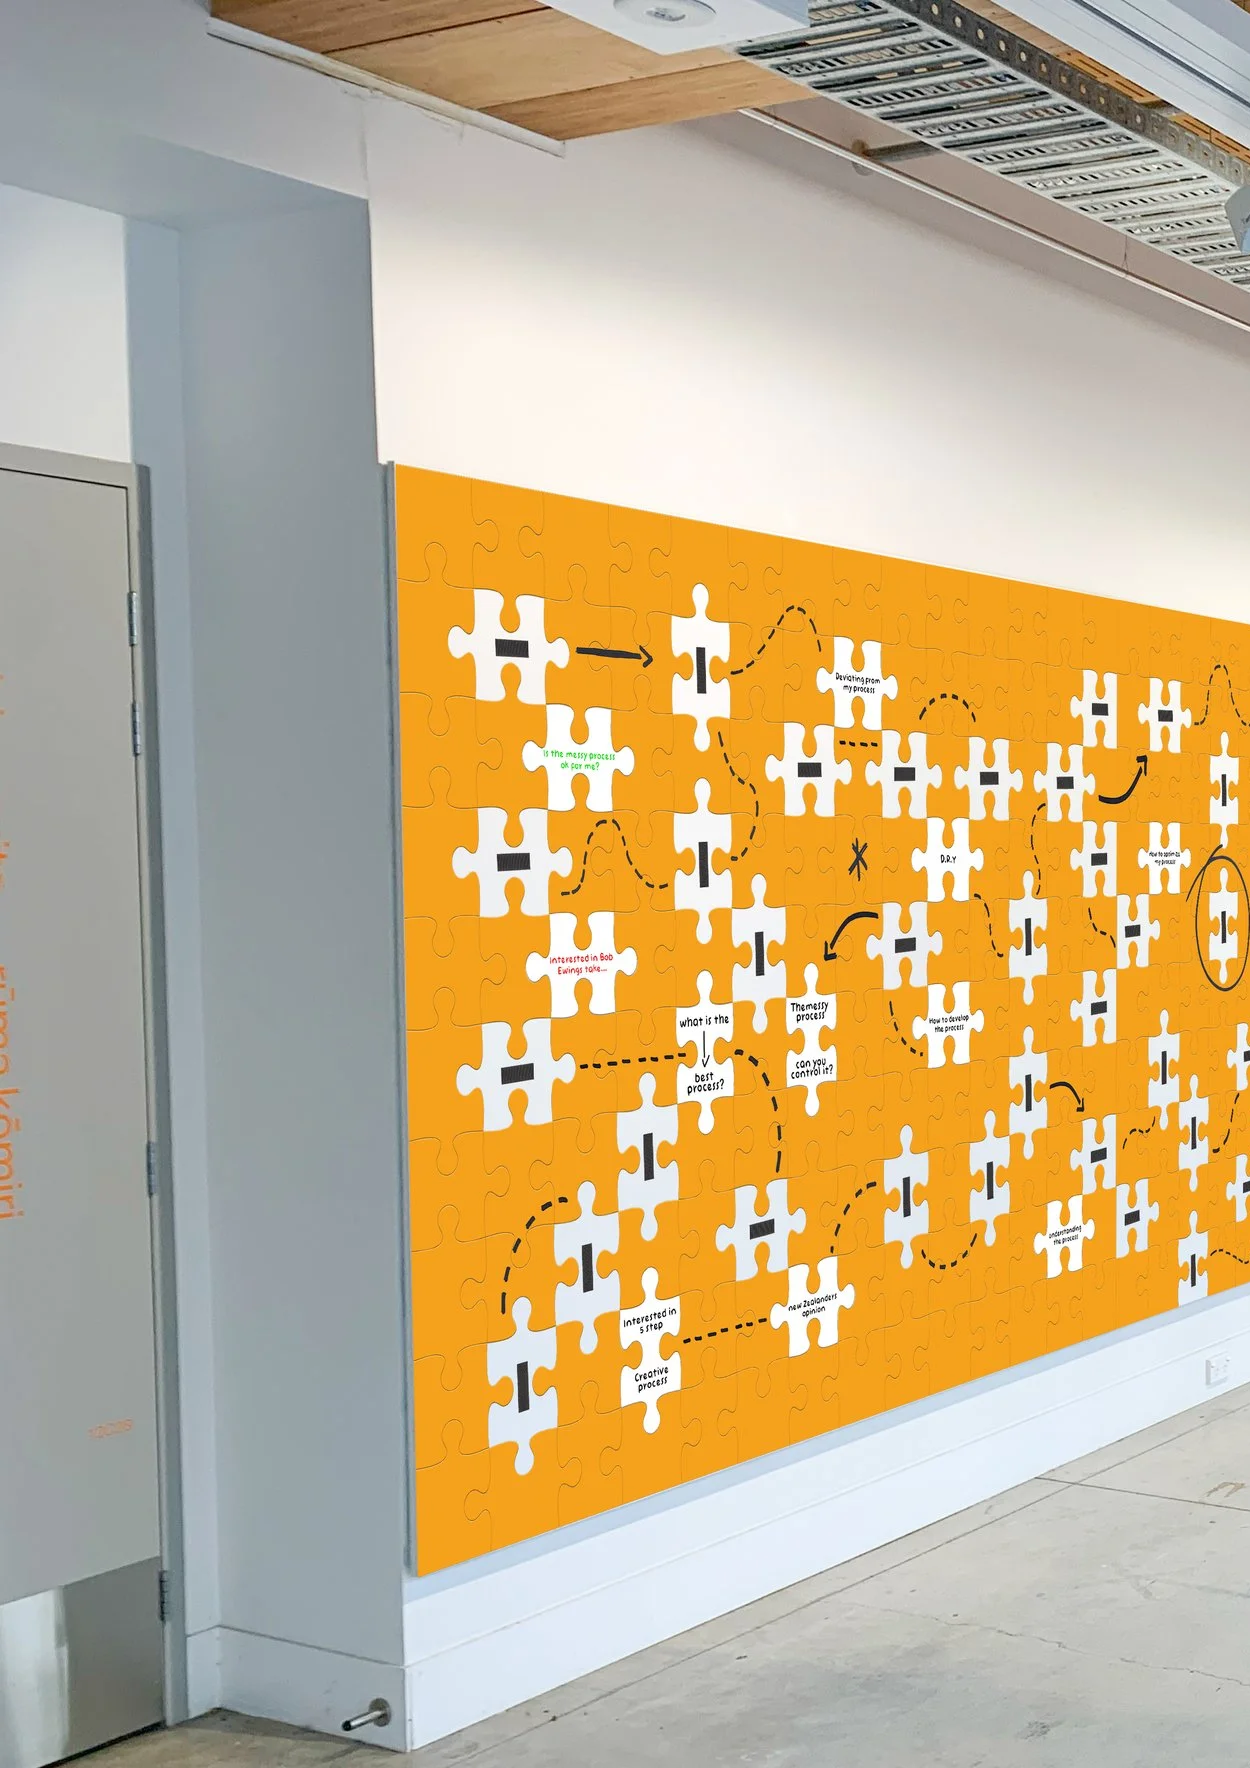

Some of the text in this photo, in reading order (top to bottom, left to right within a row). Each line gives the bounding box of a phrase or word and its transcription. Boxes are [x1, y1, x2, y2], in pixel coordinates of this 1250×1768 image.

[835, 672, 881, 686] Deviating from
[842, 685, 876, 695] my process
[551, 749, 564, 759] the
[565, 751, 588, 761] messy
[588, 752, 616, 762] process
[560, 761, 569, 770] ok
[584, 761, 600, 771] me?
[549, 952, 614, 965] Interested in Bob
[557, 965, 583, 976] Ewings
[705, 1015, 712, 1026] is
[714, 1014, 730, 1025] the
[796, 1011, 826, 1024] process
[949, 1014, 970, 1023] develop
[944, 1024, 965, 1034] process
[795, 1057, 827, 1070] can you
[694, 1071, 715, 1084] best
[790, 1064, 834, 1080] control it?
[687, 1078, 726, 1097] process?
[623, 1302, 678, 1328] Interested in
[645, 1321, 664, 1333] step
[634, 1366, 670, 1383] Creative
[637, 1376, 669, 1394] process
